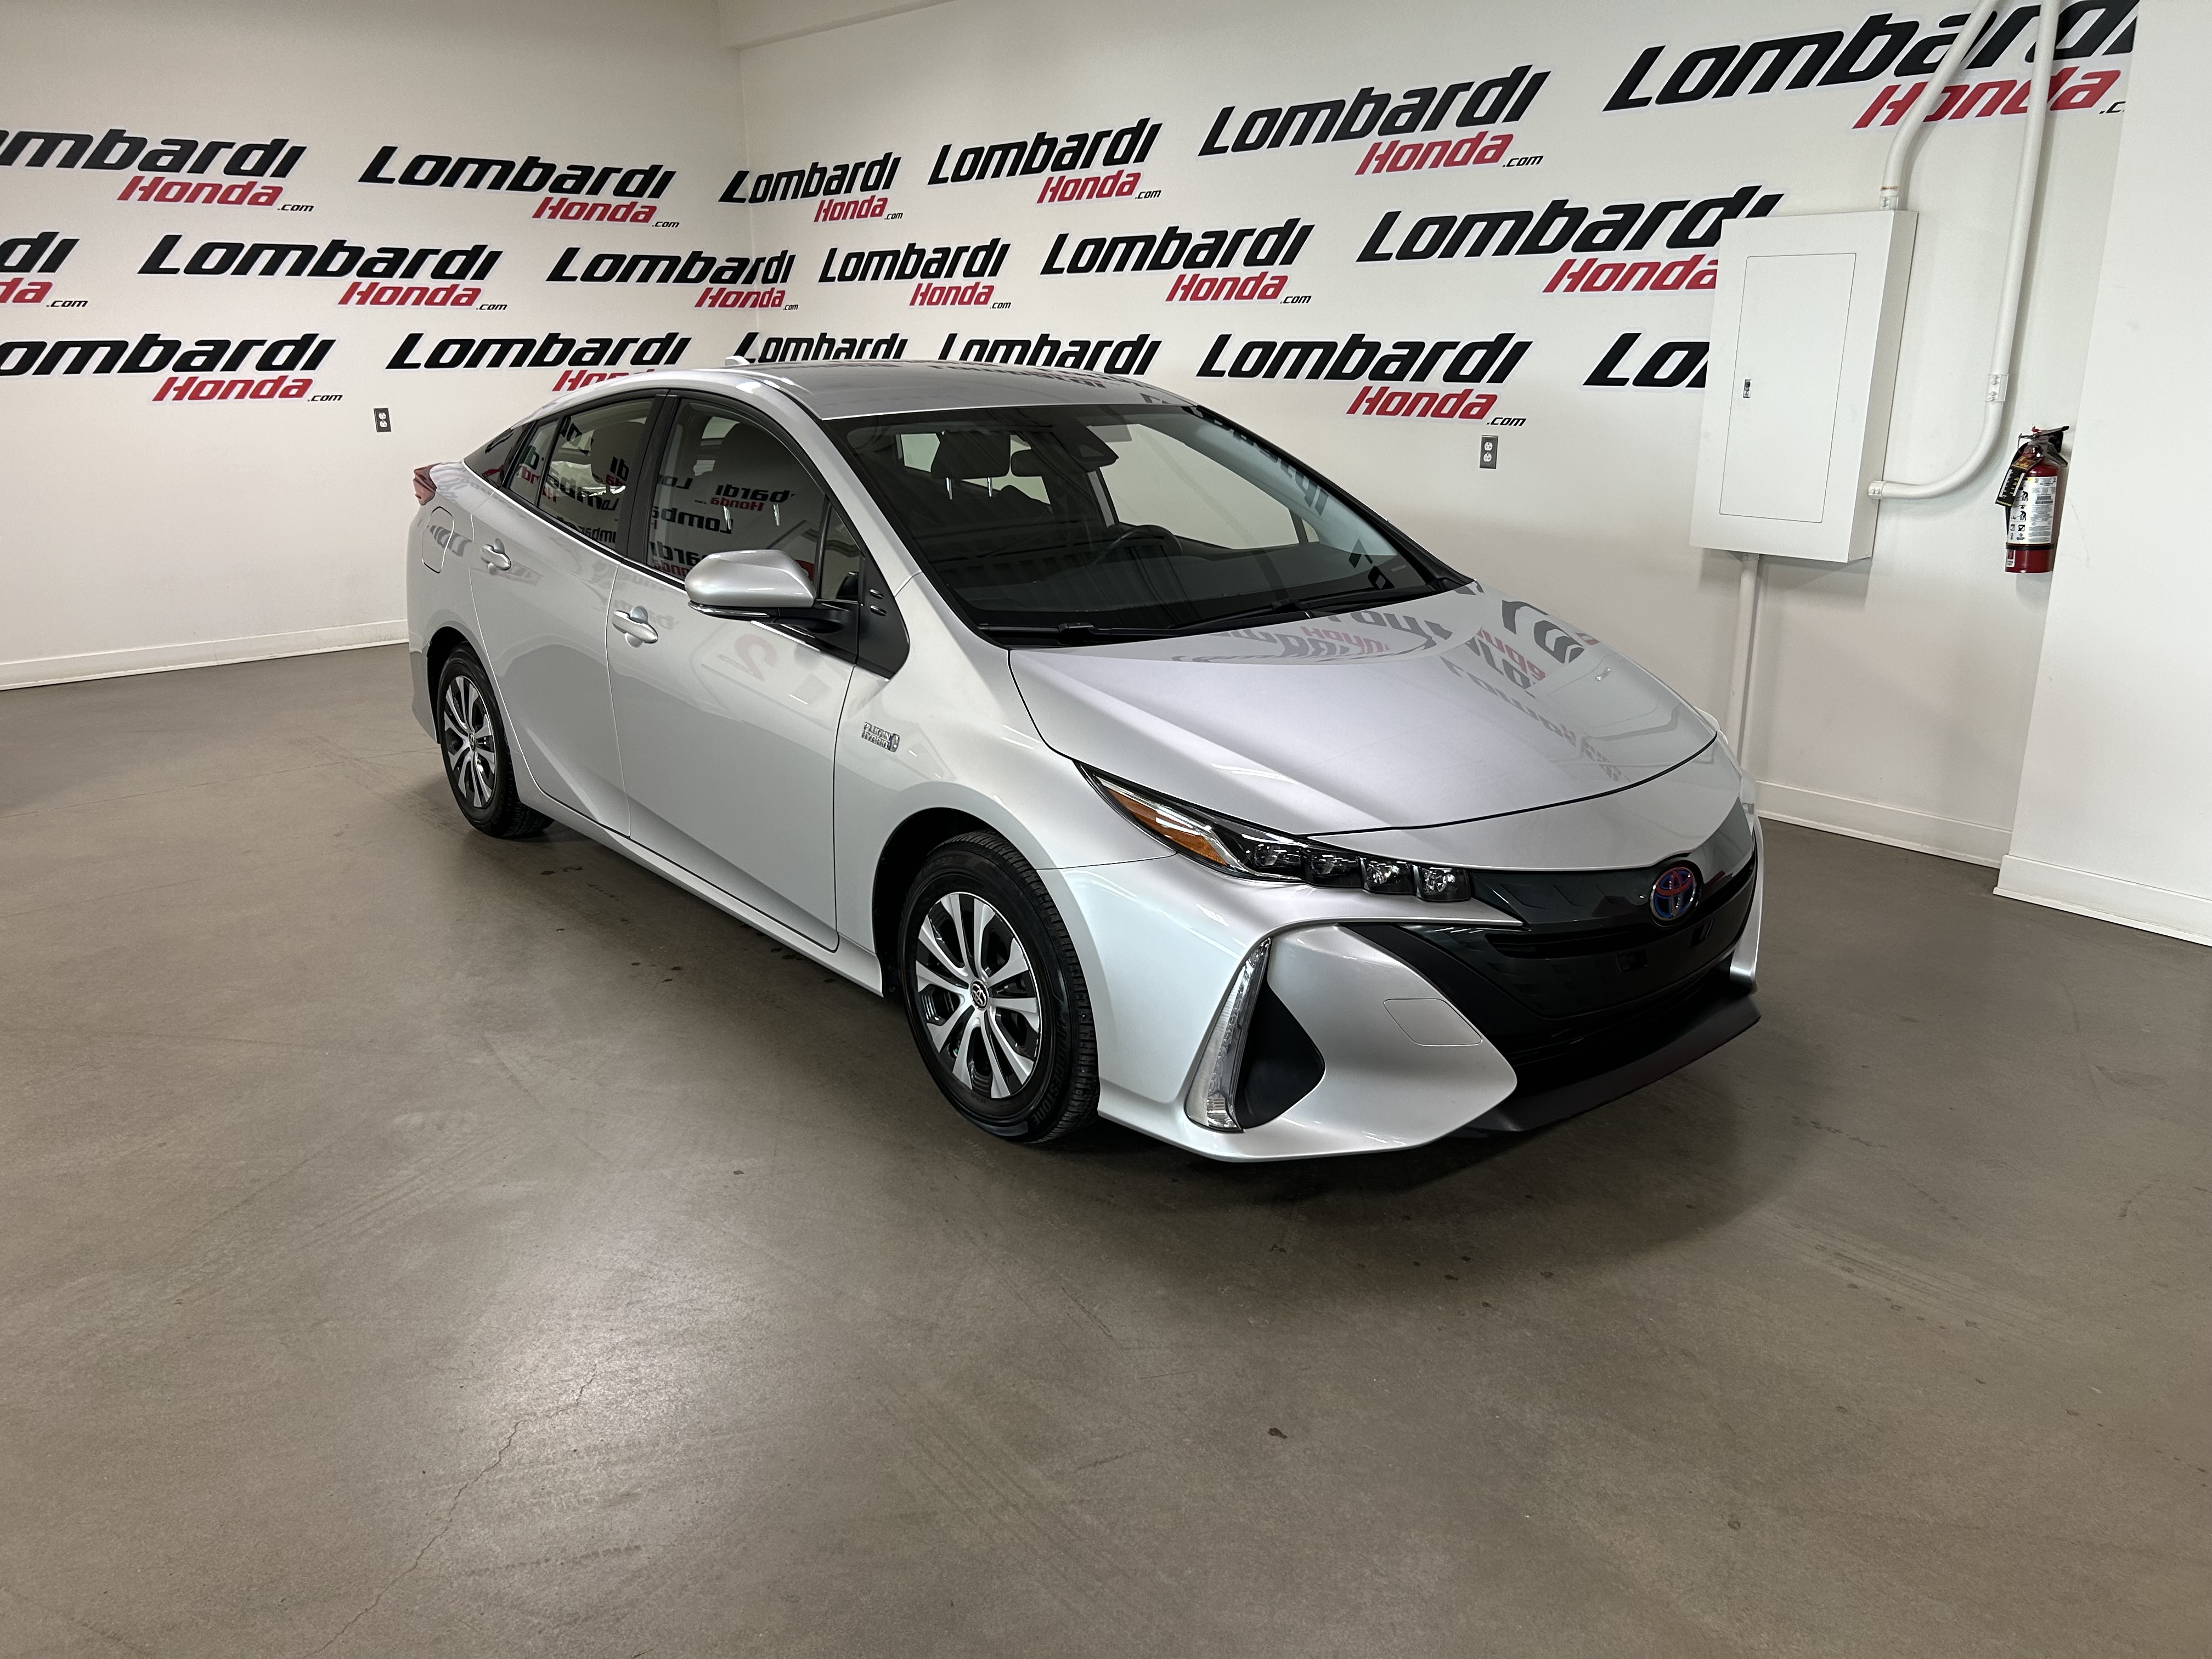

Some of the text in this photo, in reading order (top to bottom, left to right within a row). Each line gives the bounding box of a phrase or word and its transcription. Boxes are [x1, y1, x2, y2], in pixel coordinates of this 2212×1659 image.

[1198, 65, 1551, 157] Lombardi
[0, 129, 307, 178] mbardi
[928, 117, 1163, 185] Lombardi
[1355, 131, 1514, 175] Honda
[117, 176, 283, 206] Honda
[358, 146, 676, 199] Lombardi
[718, 152, 901, 204] Lombardi
[1037, 170, 1141, 204] Honda
[532, 197, 657, 223] Honda
[814, 195, 888, 222] Honda
[137, 235, 503, 280] Lombardi
[819, 238, 1011, 283] Lombardi
[1040, 218, 1315, 275] Lombardi
[546, 247, 796, 284] Lombardi
[338, 281, 482, 306] Honda
[695, 287, 785, 308] Honda
[910, 282, 994, 306] Honda
[1165, 272, 1288, 301] Honda
[0, 334, 336, 376] ombardi
[386, 333, 692, 369] Lombardi
[1196, 333, 1533, 383] Lombardi
[153, 375, 313, 401] Honda
[1346, 386, 1497, 420] Honda
